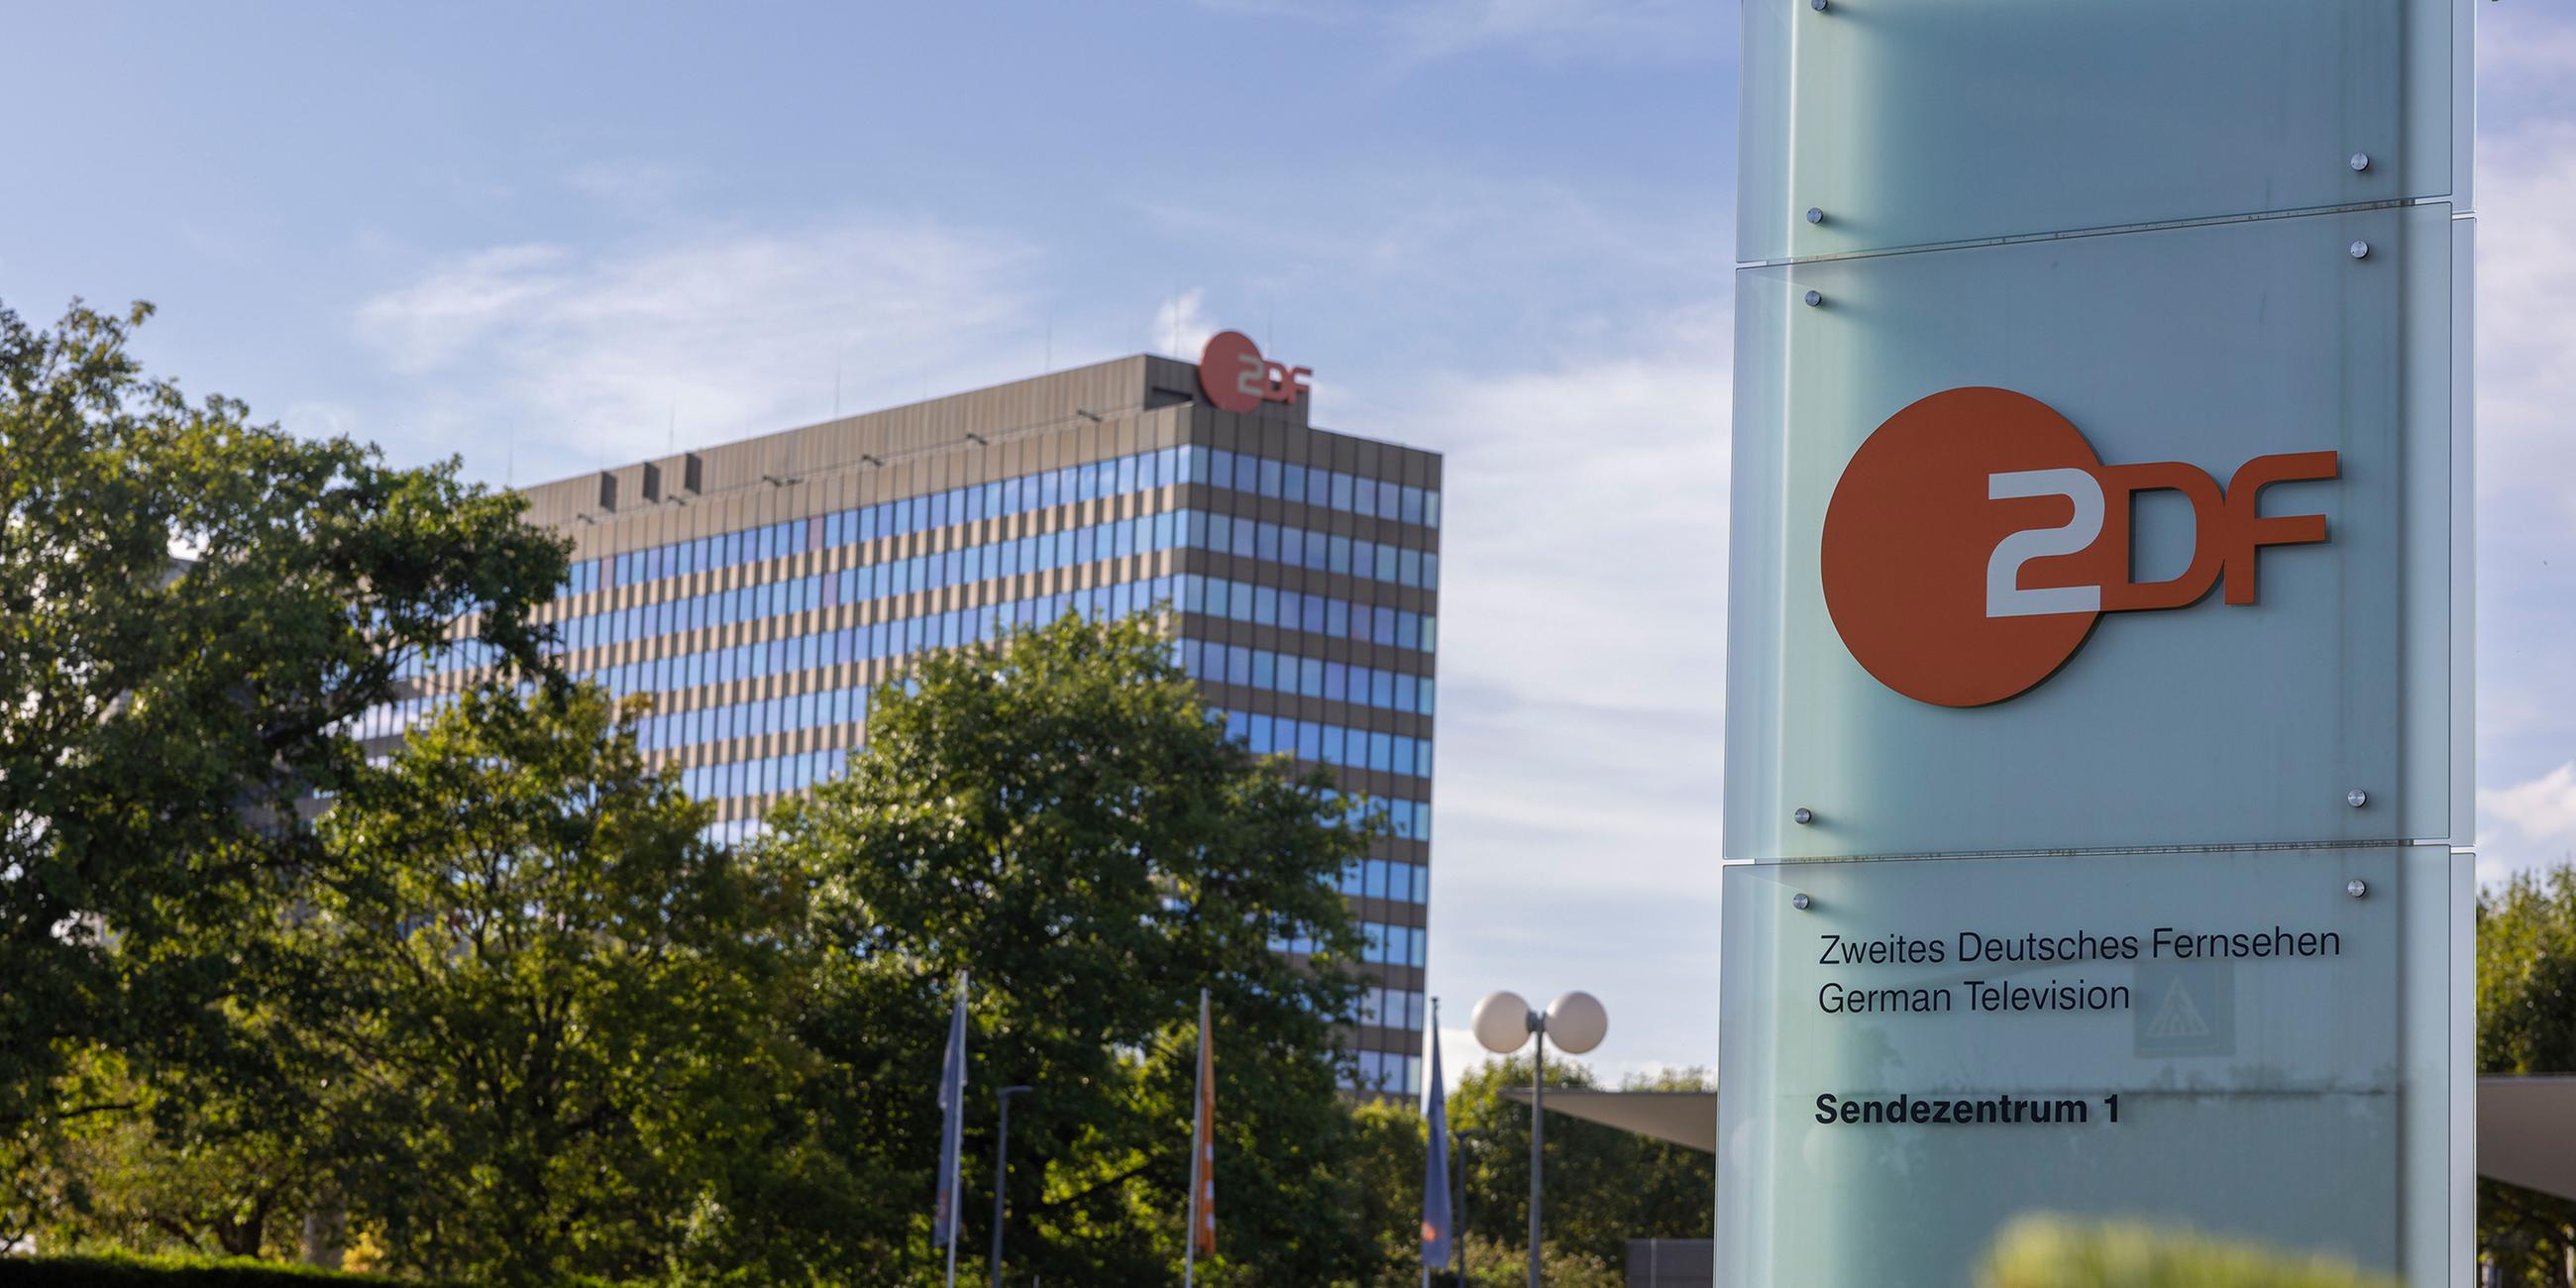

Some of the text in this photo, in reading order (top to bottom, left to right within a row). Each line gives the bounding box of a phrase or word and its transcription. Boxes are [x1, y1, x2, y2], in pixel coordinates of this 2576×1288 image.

[1819, 925, 2340, 965] Zweites Deutsches Fernsehen
[1819, 980, 2129, 1014] German Television
[1815, 1093, 2120, 1125] Sendezentrum 1
